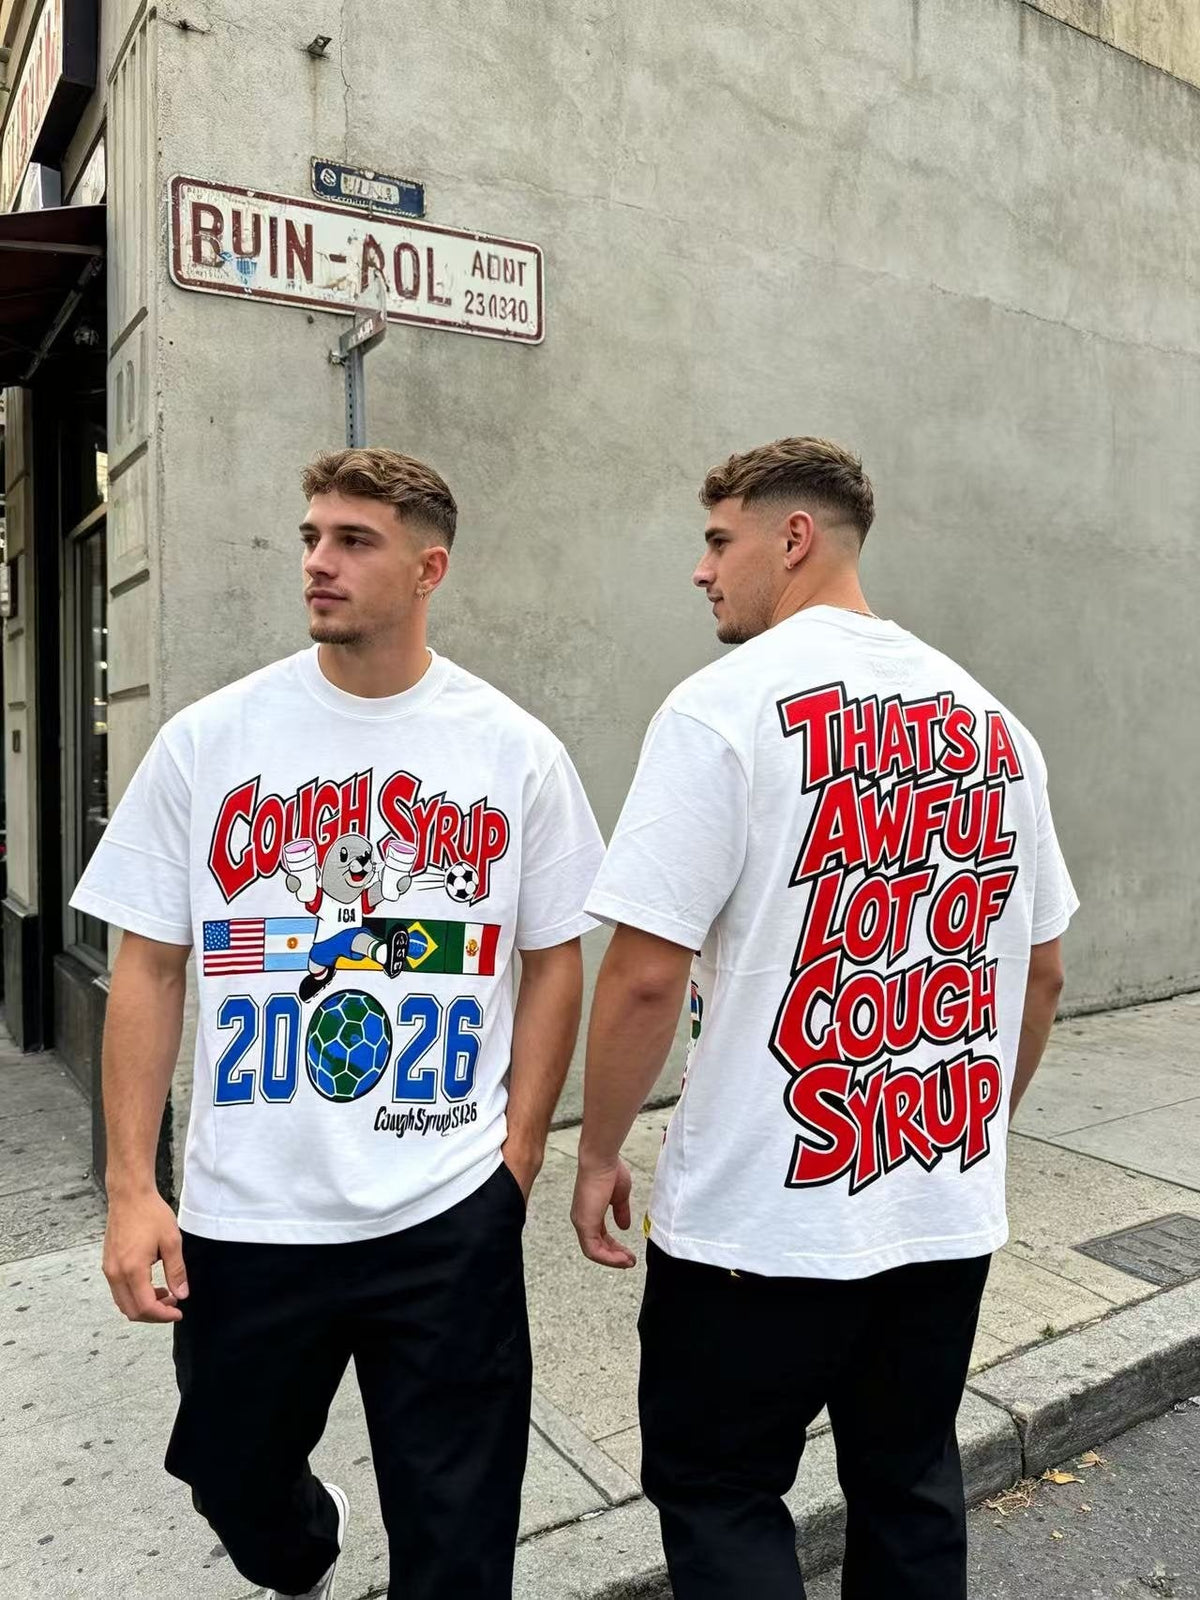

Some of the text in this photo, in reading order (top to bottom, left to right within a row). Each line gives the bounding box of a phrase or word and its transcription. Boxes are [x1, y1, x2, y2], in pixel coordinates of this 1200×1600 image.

[776, 681, 1024, 795] THAT'S A
[208, 767, 510, 906] COUGH SYRUP
[788, 774, 1017, 888] AWFUL
[790, 864, 1019, 977] LOT OF
[768, 950, 998, 1077] COUGH
[783, 1048, 1002, 1197] SYRUP
